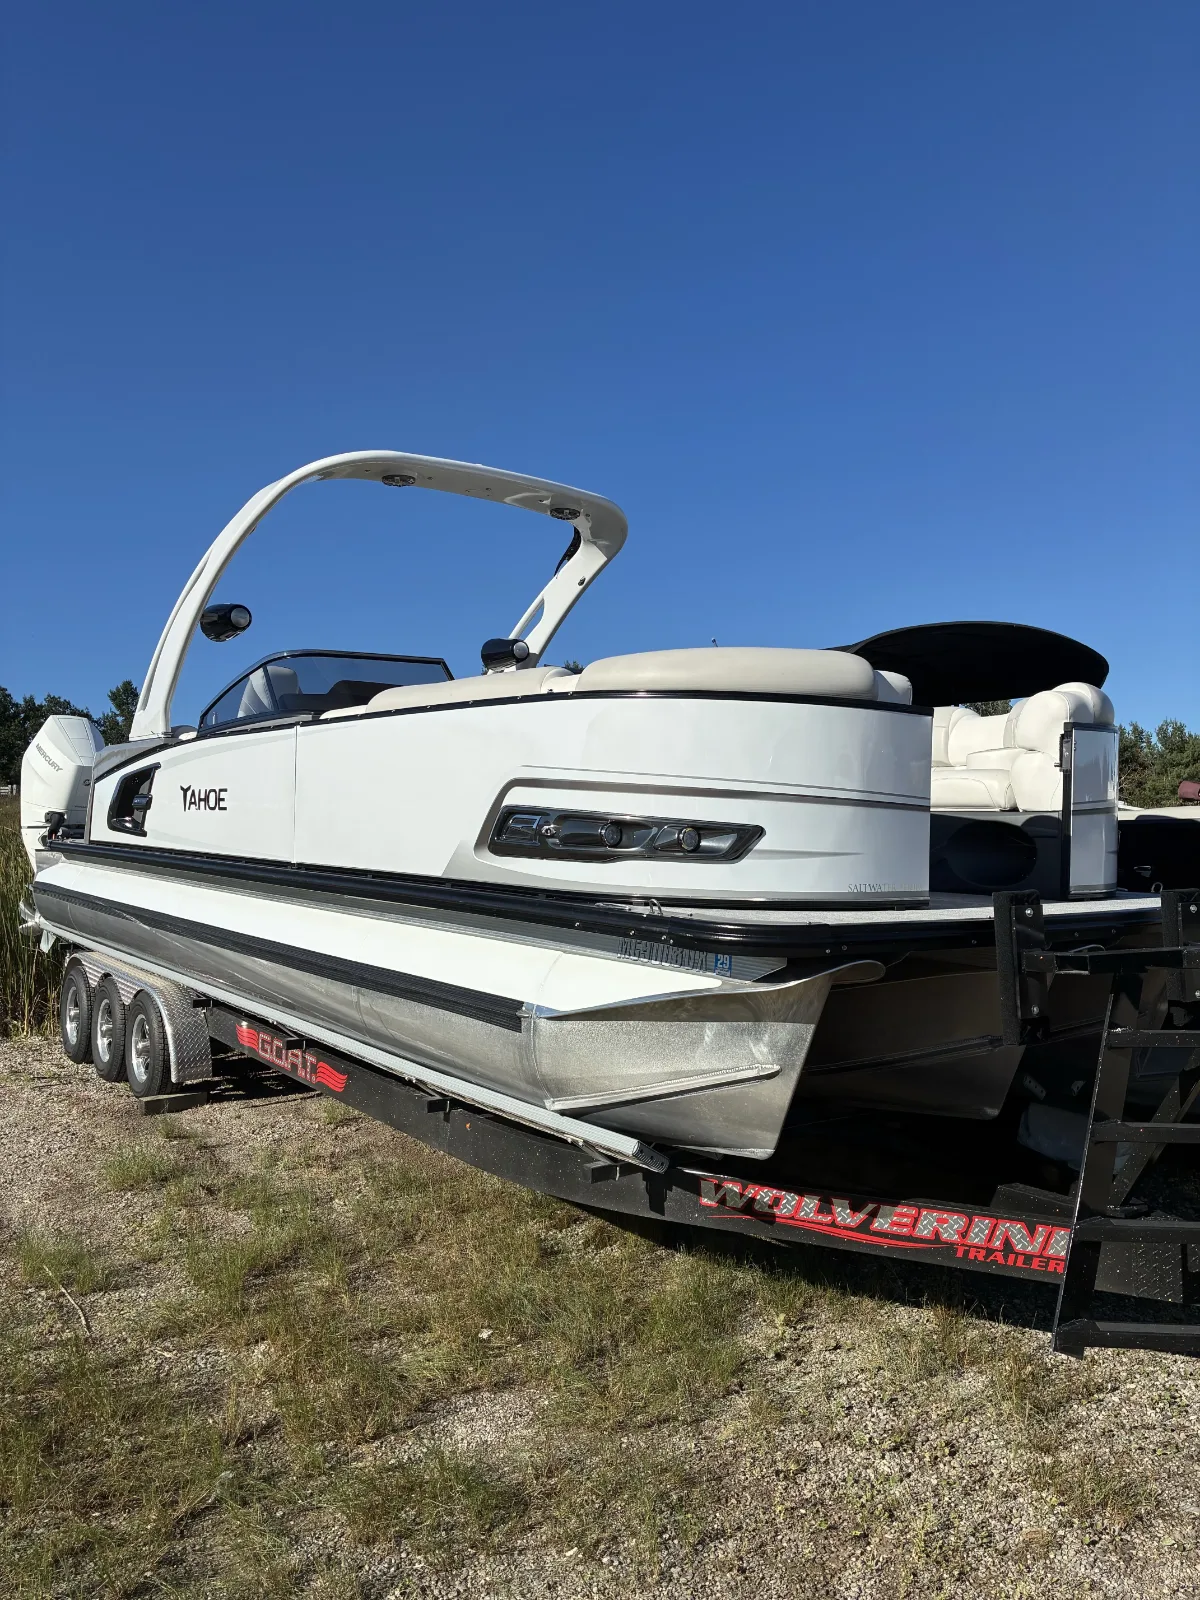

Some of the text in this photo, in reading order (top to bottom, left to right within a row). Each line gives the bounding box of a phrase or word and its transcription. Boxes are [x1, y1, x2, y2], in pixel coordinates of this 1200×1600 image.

[35, 743, 63, 772] MERCURY
[180, 784, 228, 812] TAHOE
[716, 954, 730, 968] 29
